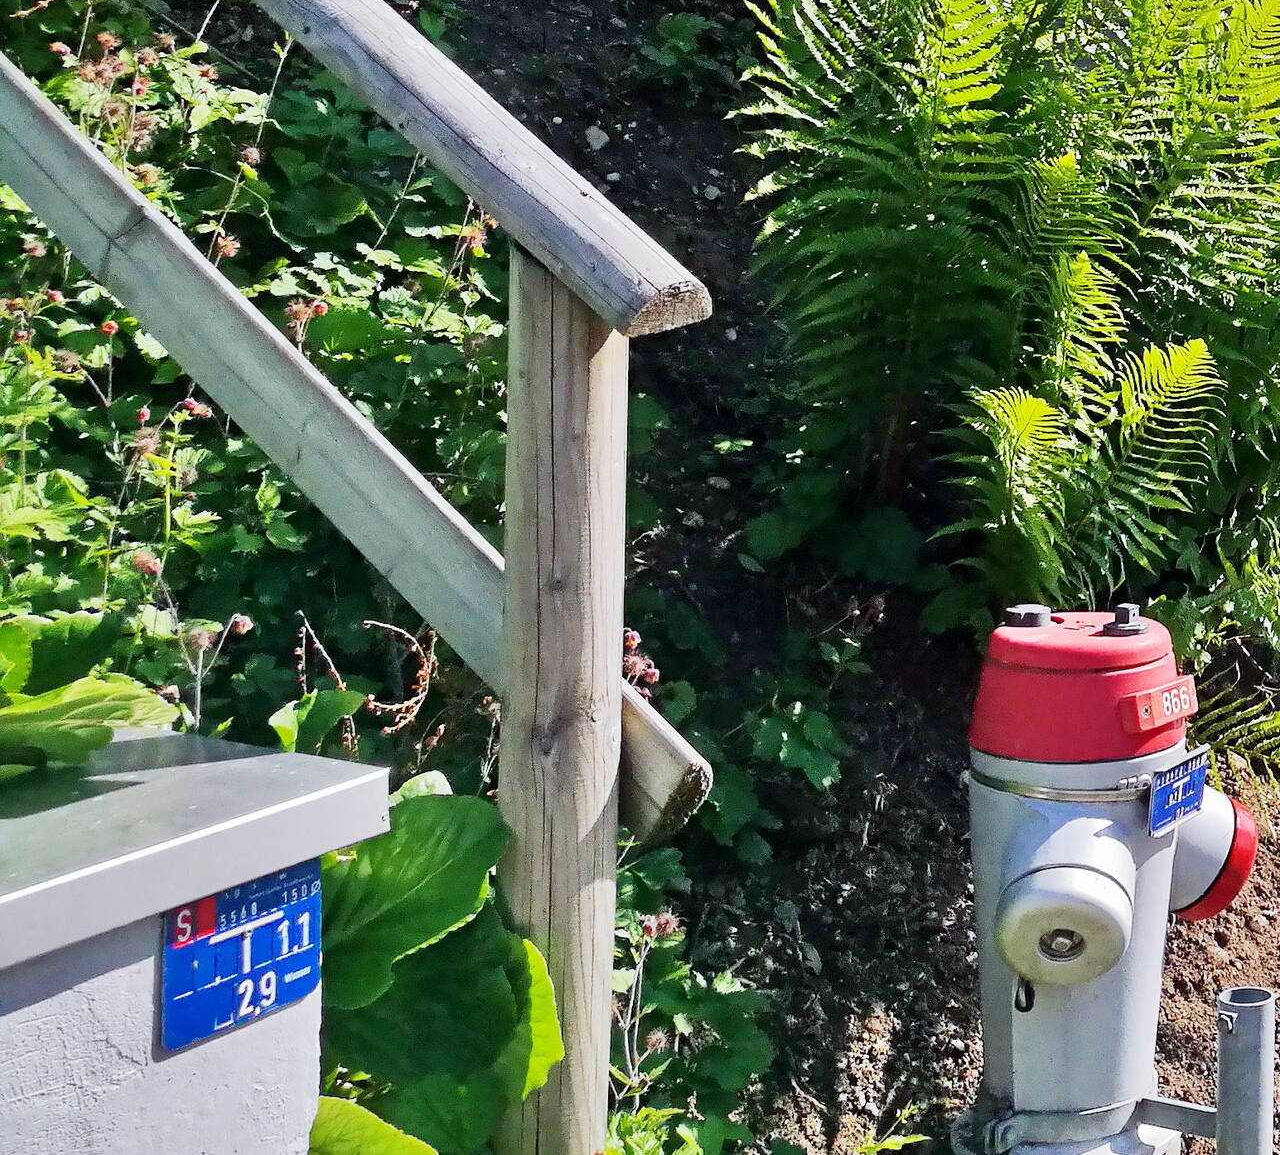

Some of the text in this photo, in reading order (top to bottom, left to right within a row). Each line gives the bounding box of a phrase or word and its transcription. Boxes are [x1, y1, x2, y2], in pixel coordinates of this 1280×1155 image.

[1162, 686, 1190, 717] 866
[176, 909, 193, 943] S
[219, 901, 258, 927] 5568
[208, 910, 285, 974] T
[237, 970, 277, 1017] 2,9
